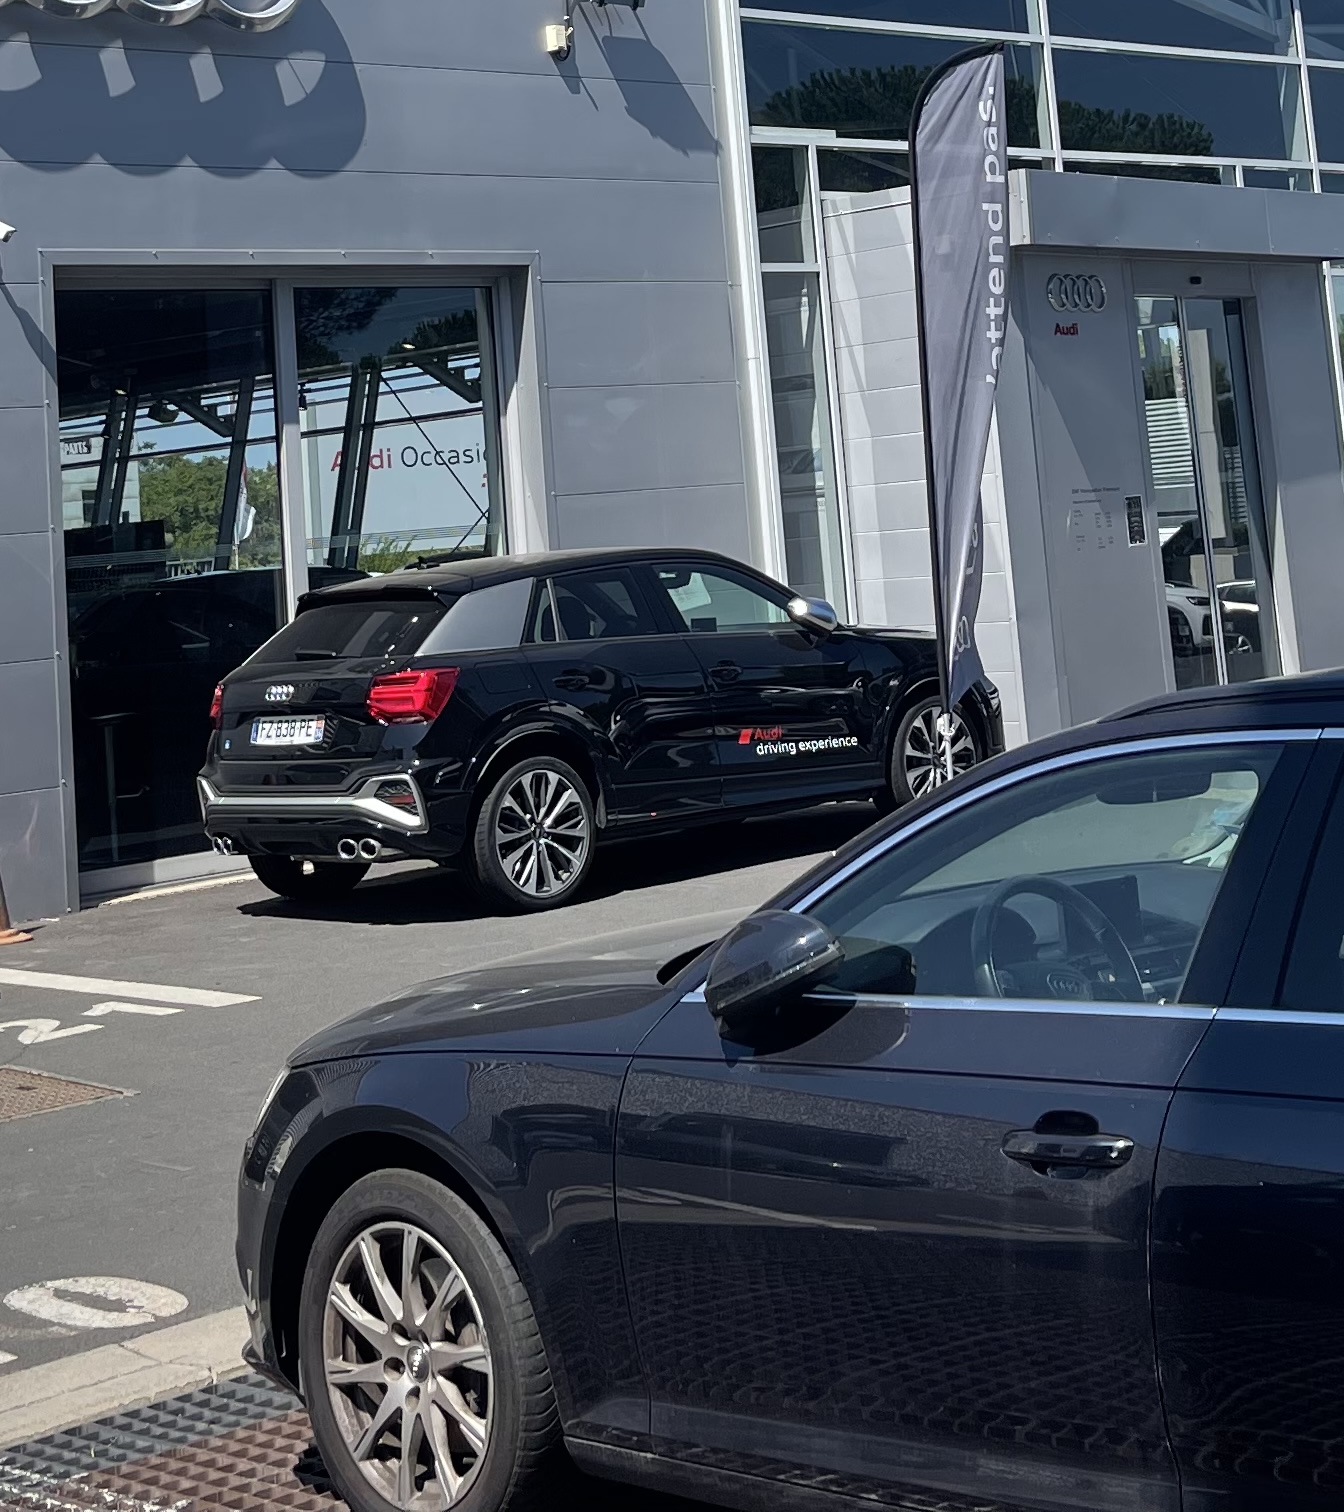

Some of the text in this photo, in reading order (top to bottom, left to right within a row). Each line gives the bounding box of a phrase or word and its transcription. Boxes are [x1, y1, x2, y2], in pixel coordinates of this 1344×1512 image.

[979, 86, 1005, 183] pas.
[1054, 322, 1078, 336] Audi
[331, 443, 487, 471] Adi Occasi
[754, 726, 783, 740] Audi
[756, 736, 858, 755] driving experience
